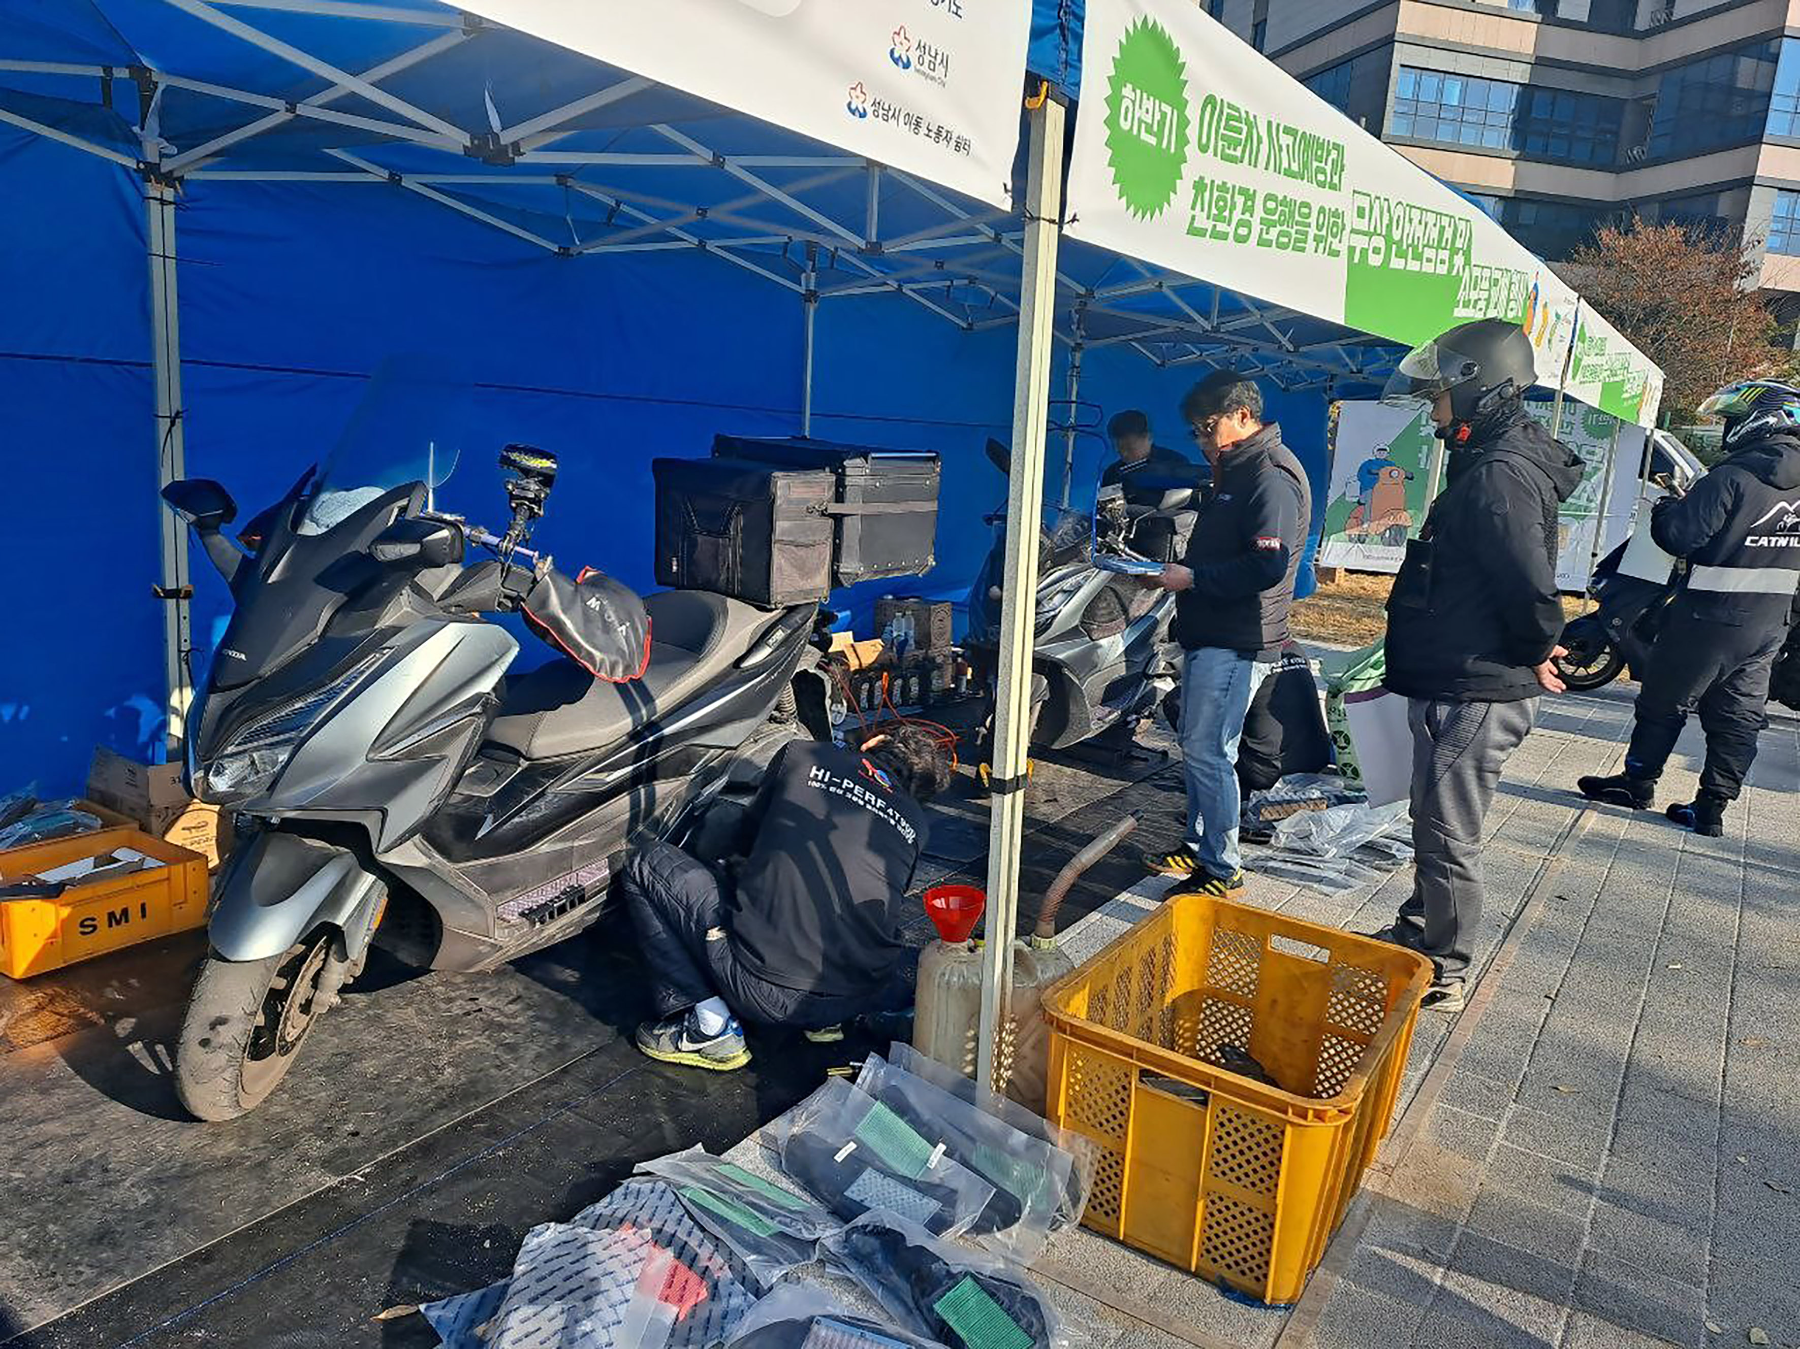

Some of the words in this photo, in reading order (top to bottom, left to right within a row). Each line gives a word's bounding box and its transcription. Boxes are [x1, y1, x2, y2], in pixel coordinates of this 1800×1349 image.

[915, 39, 949, 78] 성남시
[871, 97, 902, 127] 성남시
[903, 112, 923, 136] 이동
[924, 123, 953, 149] 노동자
[954, 135, 972, 156] 쉼터
[1119, 83, 1178, 154] 하반기
[1197, 94, 1263, 169] 이륜차
[1264, 119, 1345, 192] 사고예방과
[1186, 175, 1257, 244] 친환경
[1256, 191, 1313, 253] 운행을
[1313, 205, 1346, 258] 위한
[809, 766, 886, 809] HI-PERF
[79, 902, 148, 936] SMI
